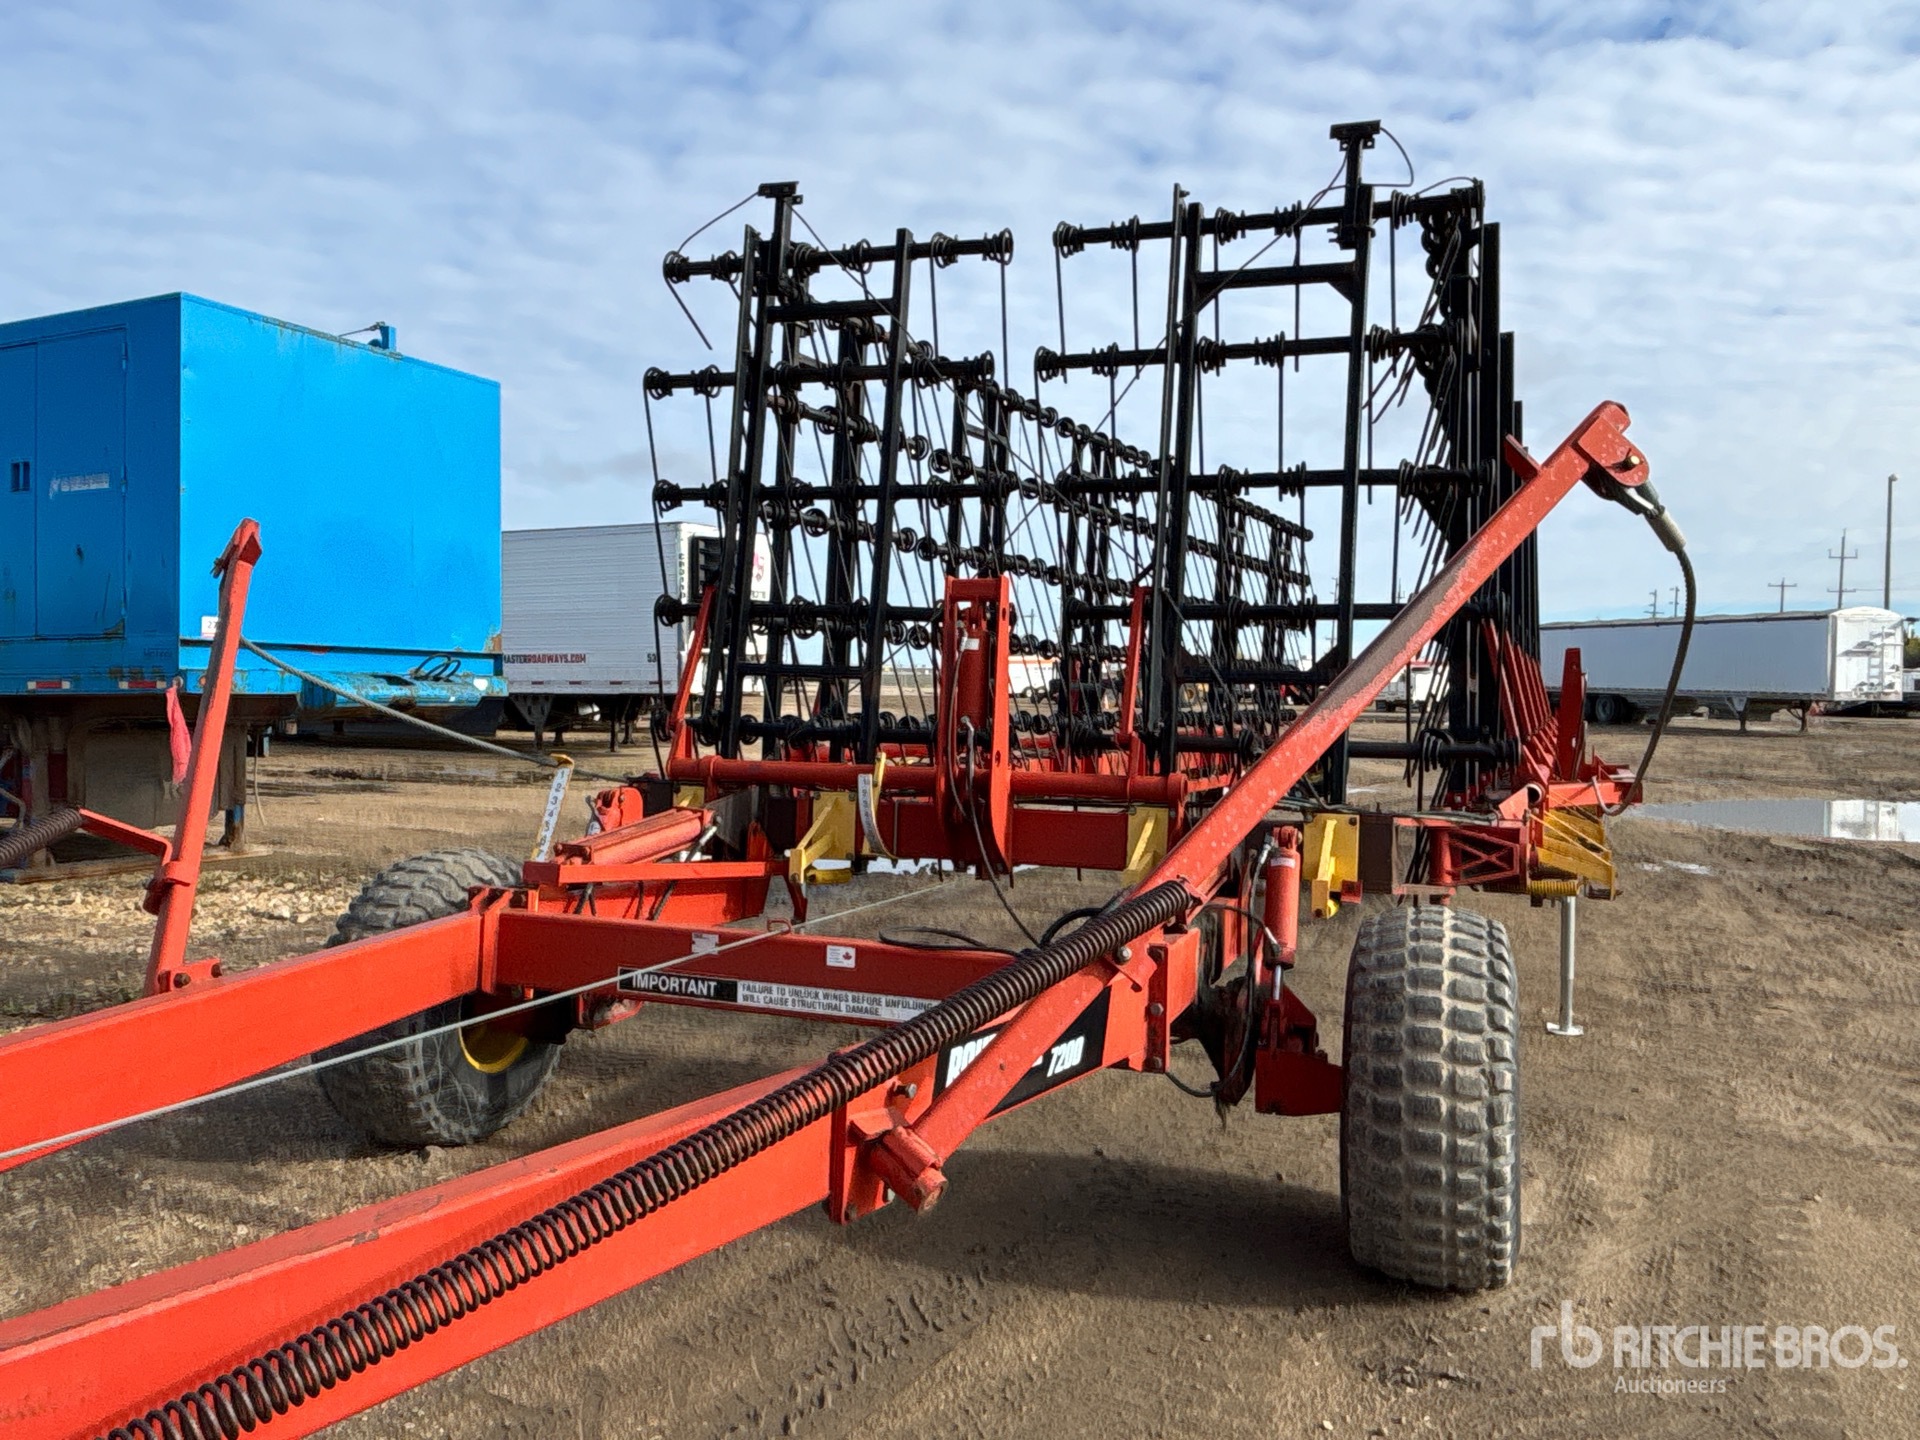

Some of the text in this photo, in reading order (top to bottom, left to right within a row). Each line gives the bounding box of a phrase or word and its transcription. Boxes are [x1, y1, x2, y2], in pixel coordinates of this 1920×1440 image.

[631, 973, 718, 997] IMPORTANT
[742, 983, 773, 995] FAILURE
[776, 986, 786, 996] TO
[788, 987, 820, 1000] UNLOCK
[822, 991, 849, 1002] WINGS
[851, 994, 883, 1006] BEFORE
[742, 994, 761, 1004] WILL
[763, 996, 789, 1007] CAUSE
[791, 998, 842, 1012] STRUCTURAL
[1047, 1035, 1085, 1078] 7200
